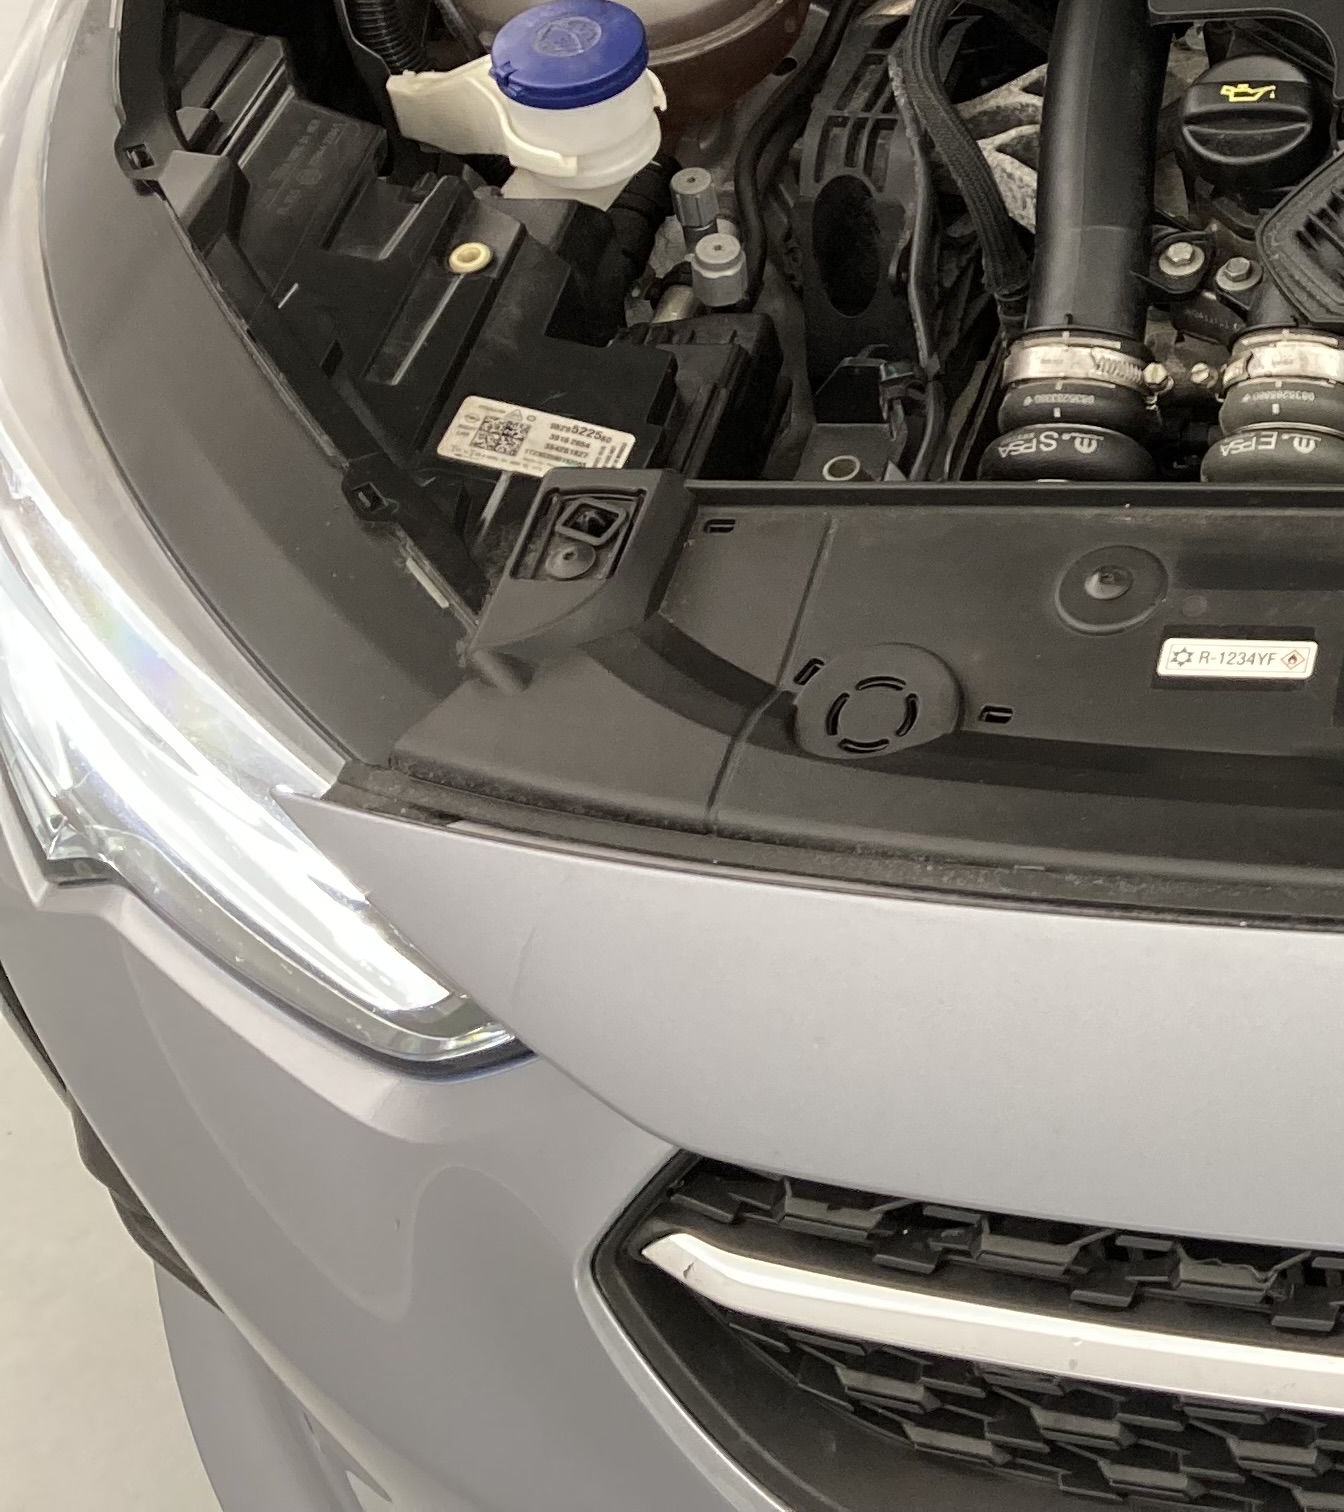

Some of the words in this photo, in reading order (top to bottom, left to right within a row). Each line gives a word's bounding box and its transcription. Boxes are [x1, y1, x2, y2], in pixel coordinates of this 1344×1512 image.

[999, 437, 1039, 458] PSA
[1220, 438, 1259, 457] PSA
[1198, 650, 1279, 666] R-1234YF
